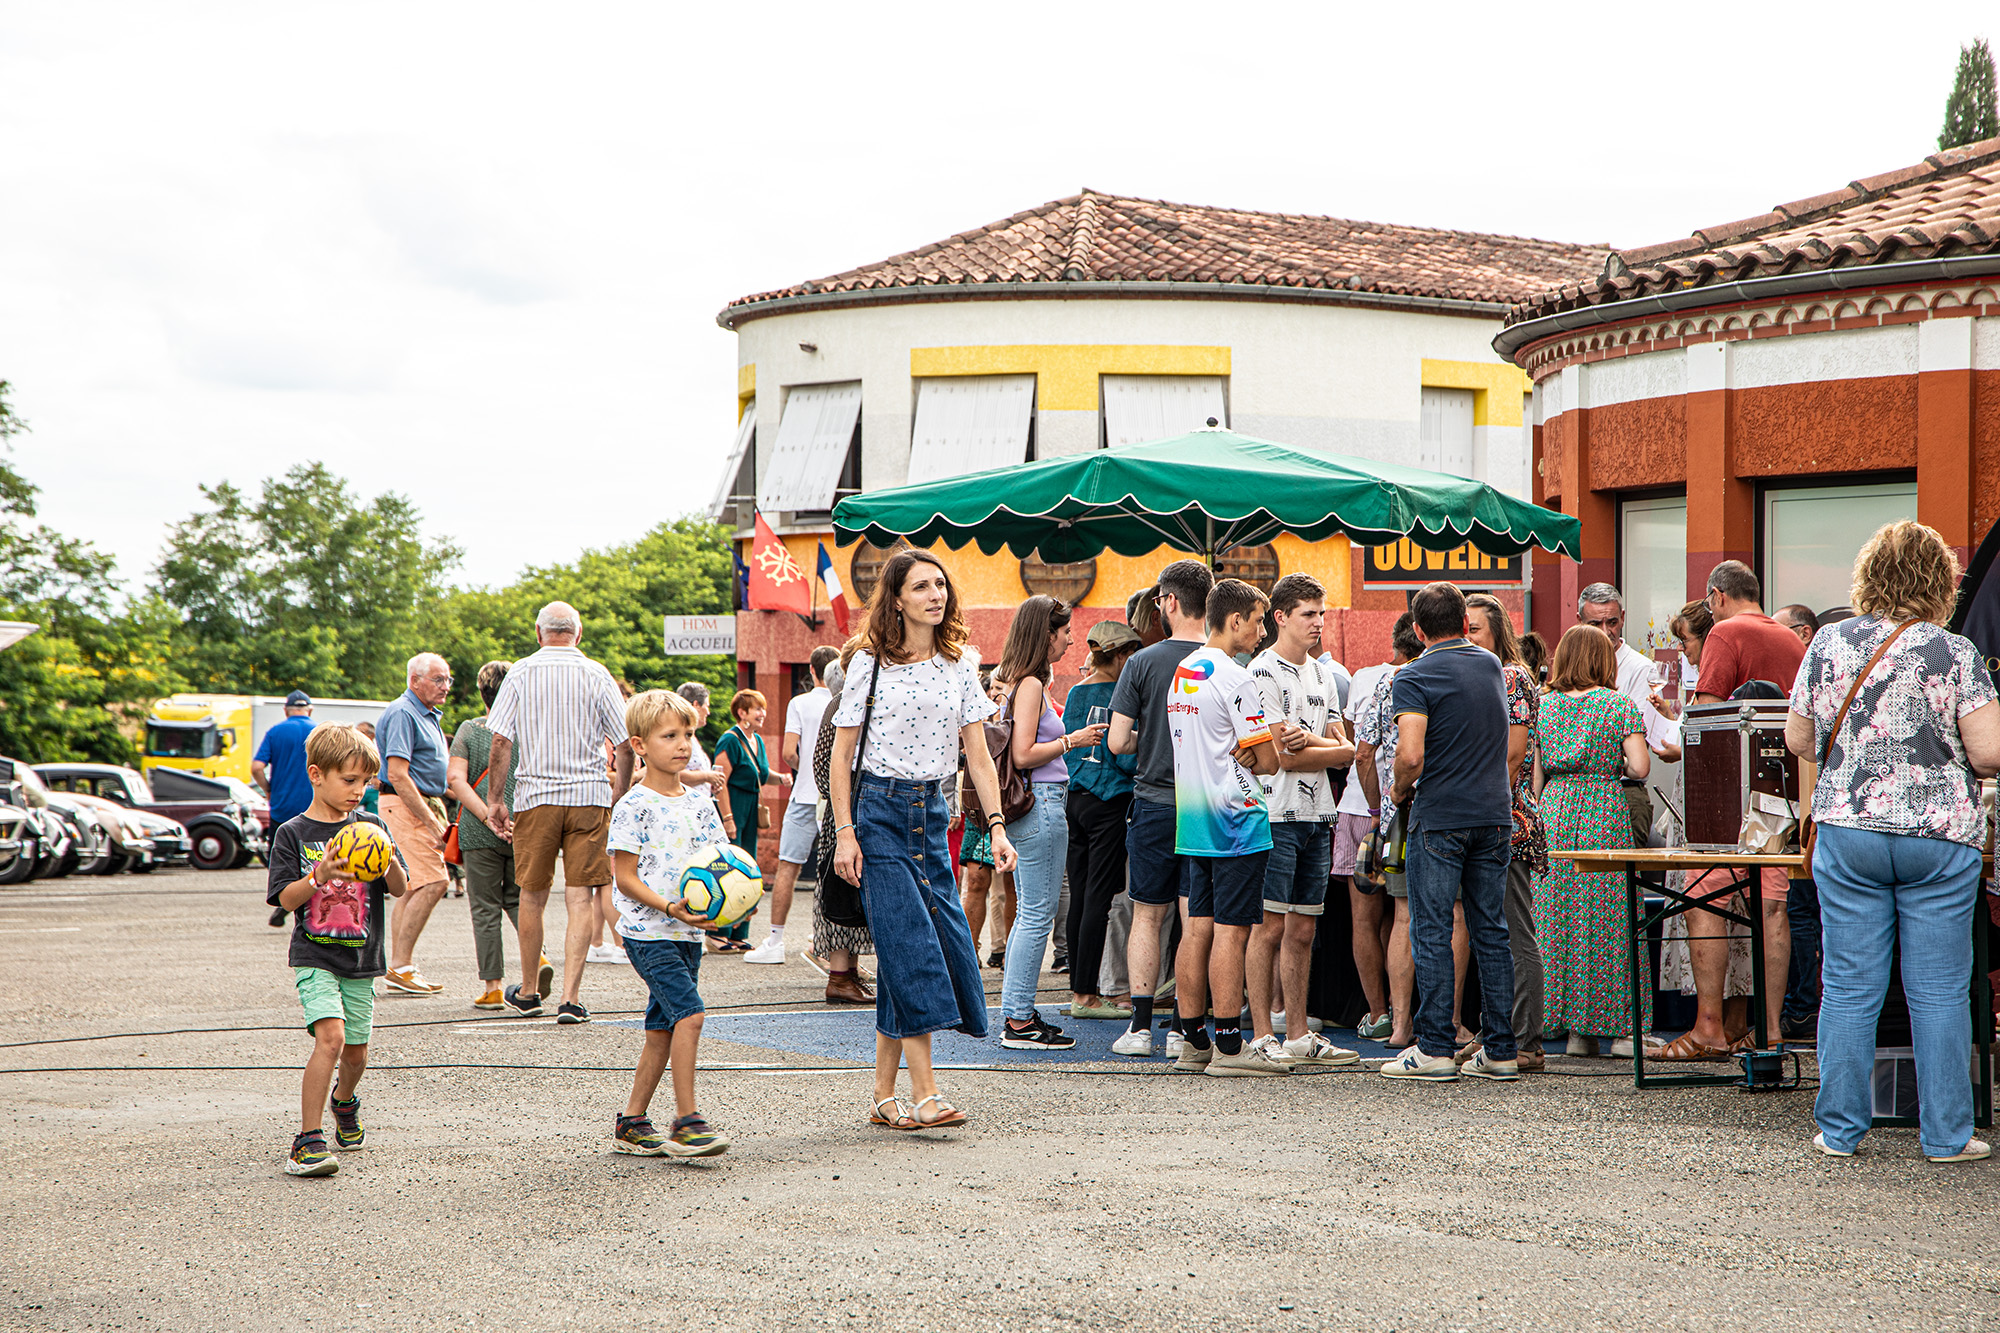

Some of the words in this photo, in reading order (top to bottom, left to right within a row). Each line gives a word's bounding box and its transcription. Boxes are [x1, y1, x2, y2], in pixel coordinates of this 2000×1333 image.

[682, 618, 718, 630] HDM
[667, 637, 735, 650] ACCUEIL
[1215, 1027, 1240, 1036] FILA
